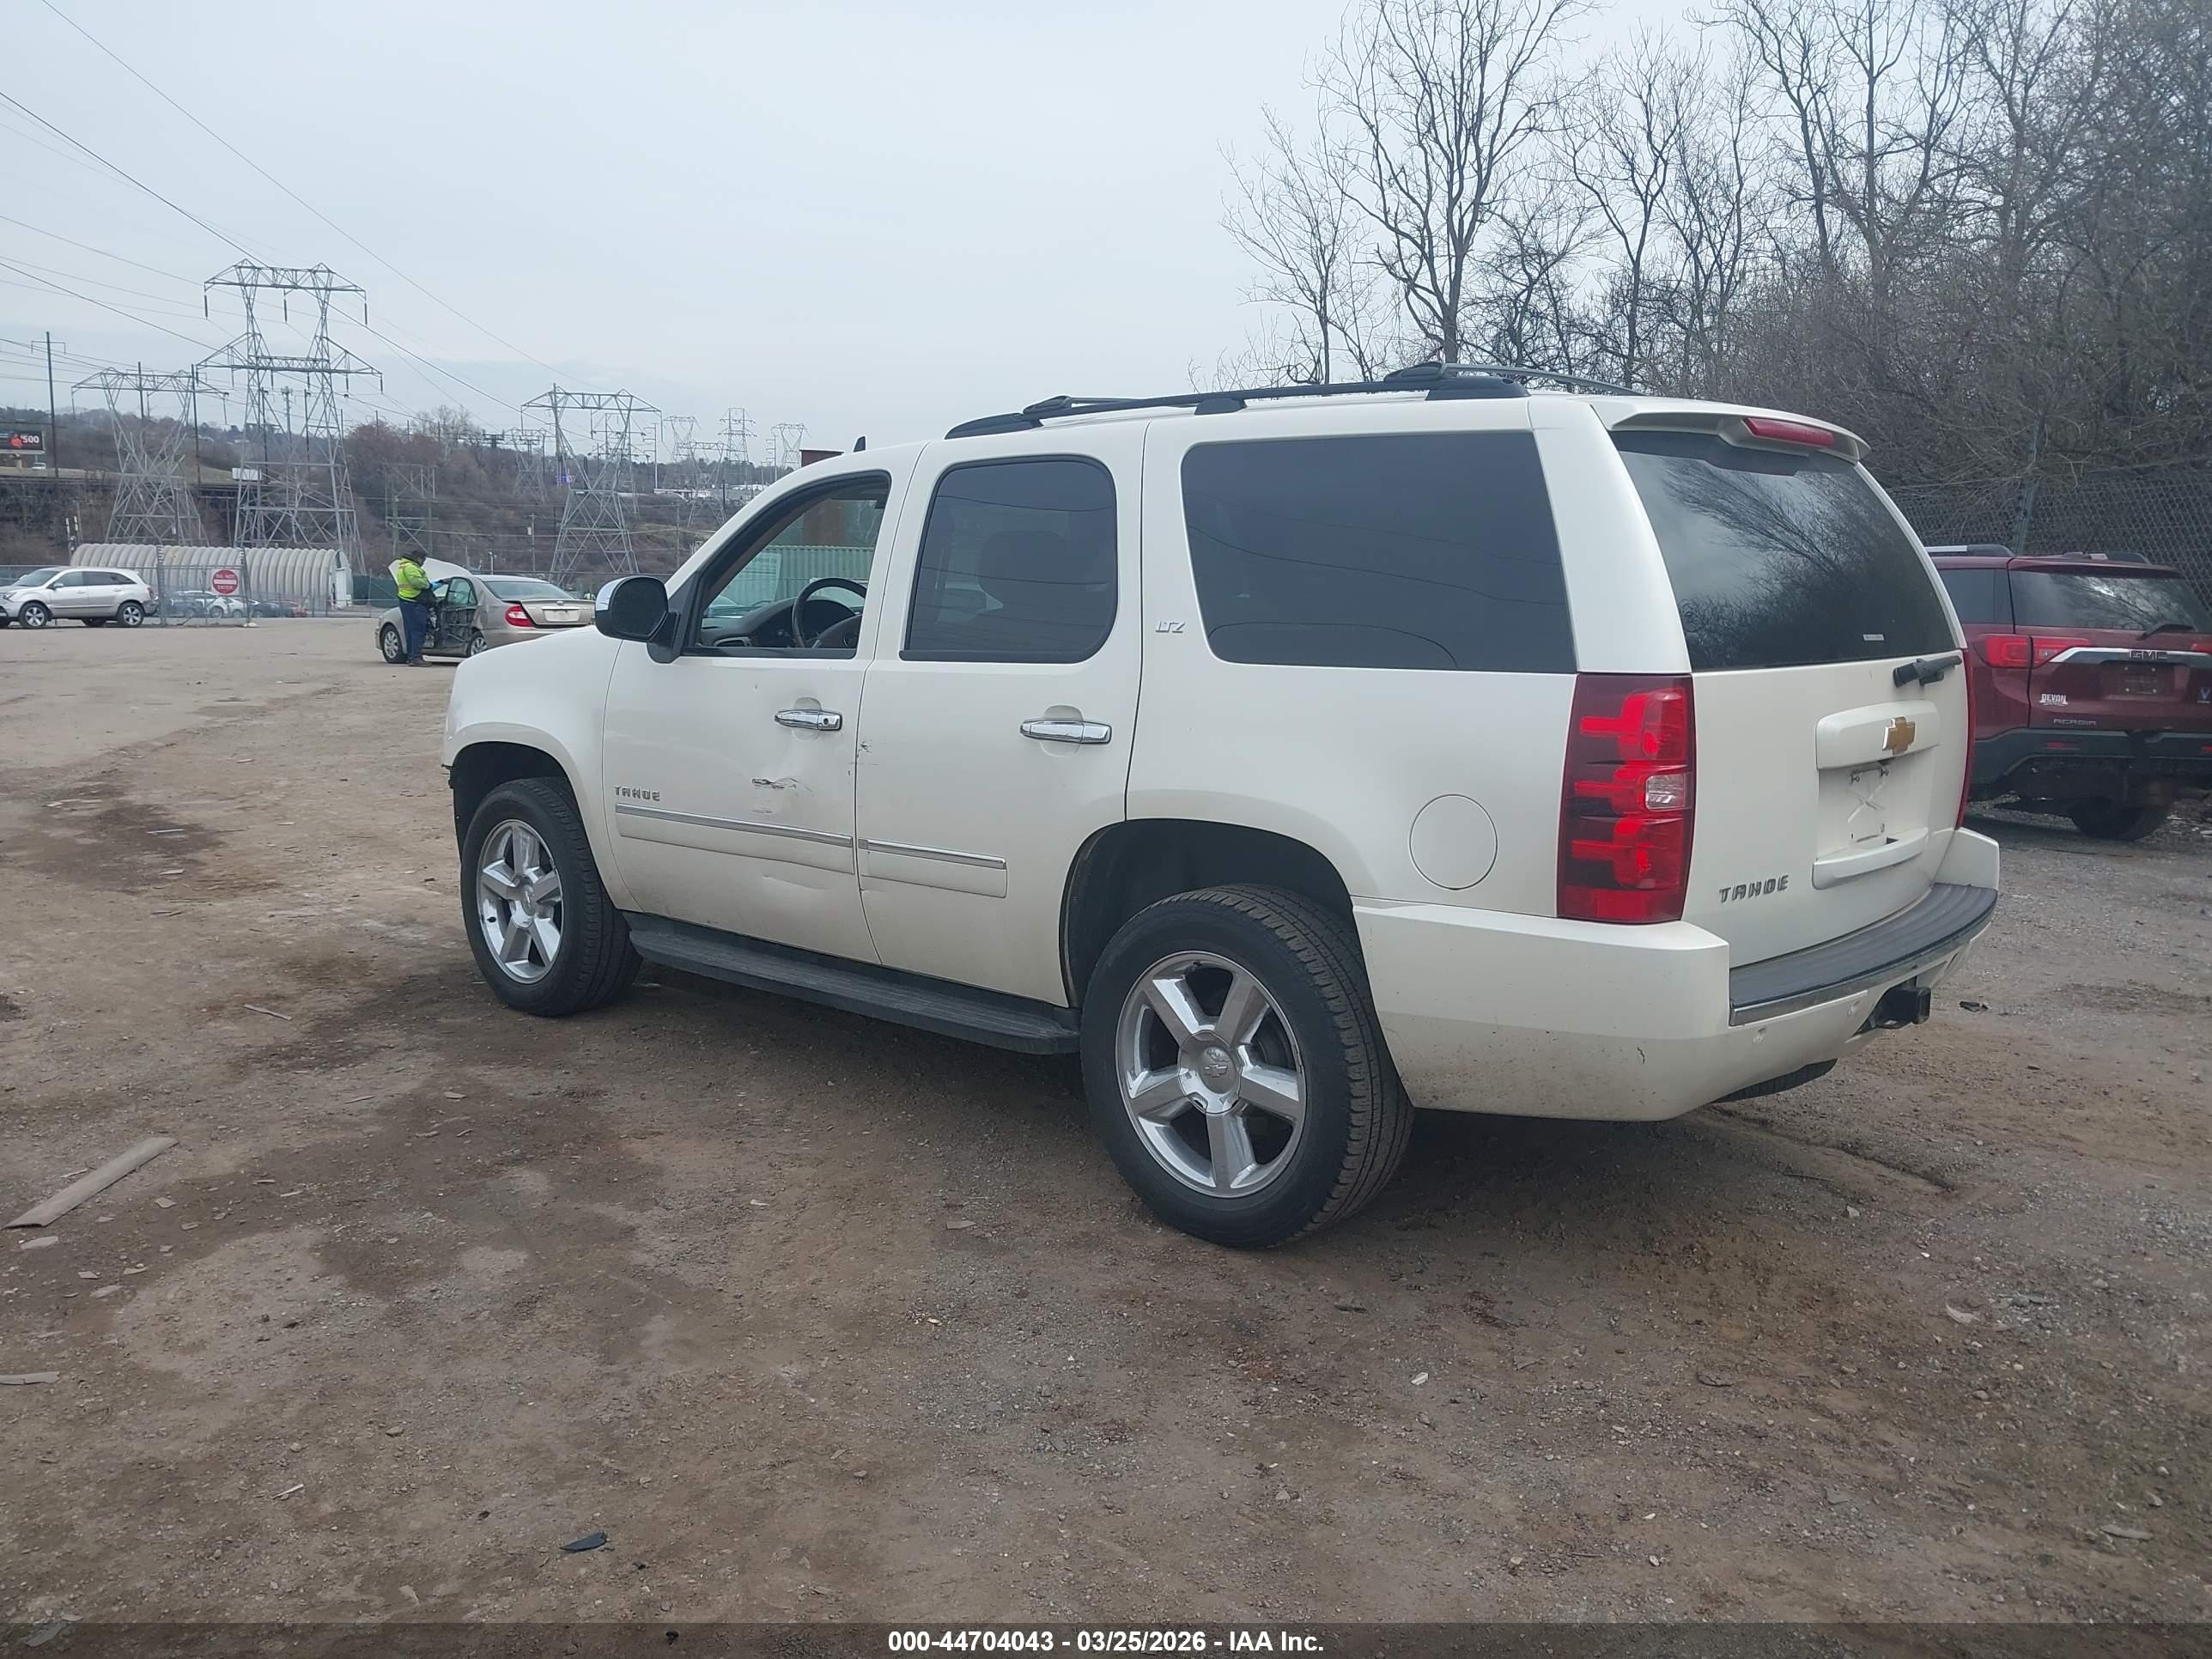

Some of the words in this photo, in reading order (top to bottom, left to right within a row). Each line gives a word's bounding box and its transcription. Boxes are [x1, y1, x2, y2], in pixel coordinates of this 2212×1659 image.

[1155, 621, 1185, 634] LTZ
[2130, 649, 2168, 660] GMC
[613, 785, 660, 802] TAHOE
[1718, 874, 1790, 904] TAHOE
